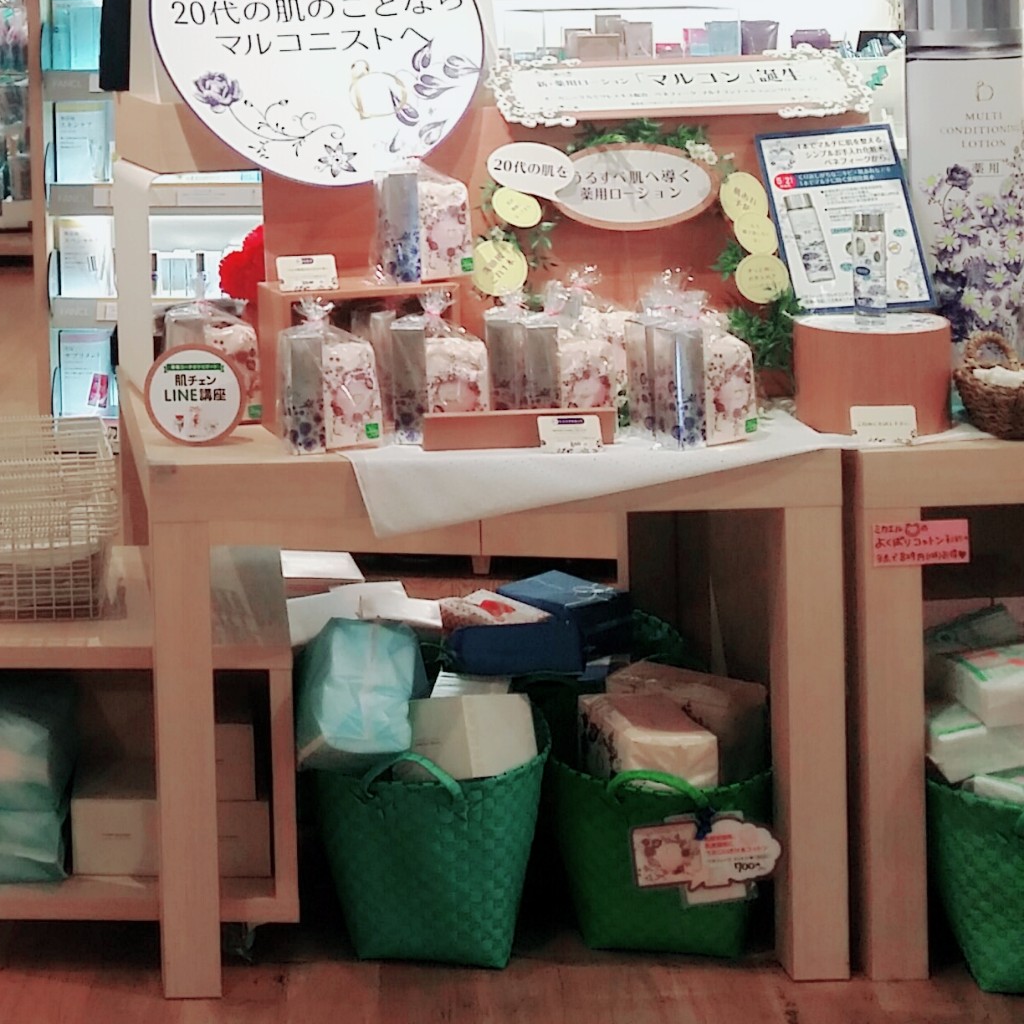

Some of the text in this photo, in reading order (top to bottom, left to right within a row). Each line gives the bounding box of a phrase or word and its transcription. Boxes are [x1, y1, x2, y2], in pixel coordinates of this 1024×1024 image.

[215, 27, 430, 55] マルコニストへ
[965, 112, 1003, 120] MULTI
[961, 140, 1006, 148] LOTION
[493, 158, 569, 179] 20代の肌を
[581, 187, 682, 201] 薬用ローション
[175, 374, 216, 386] 肌チェン
[164, 388, 227, 402] LINE講座
